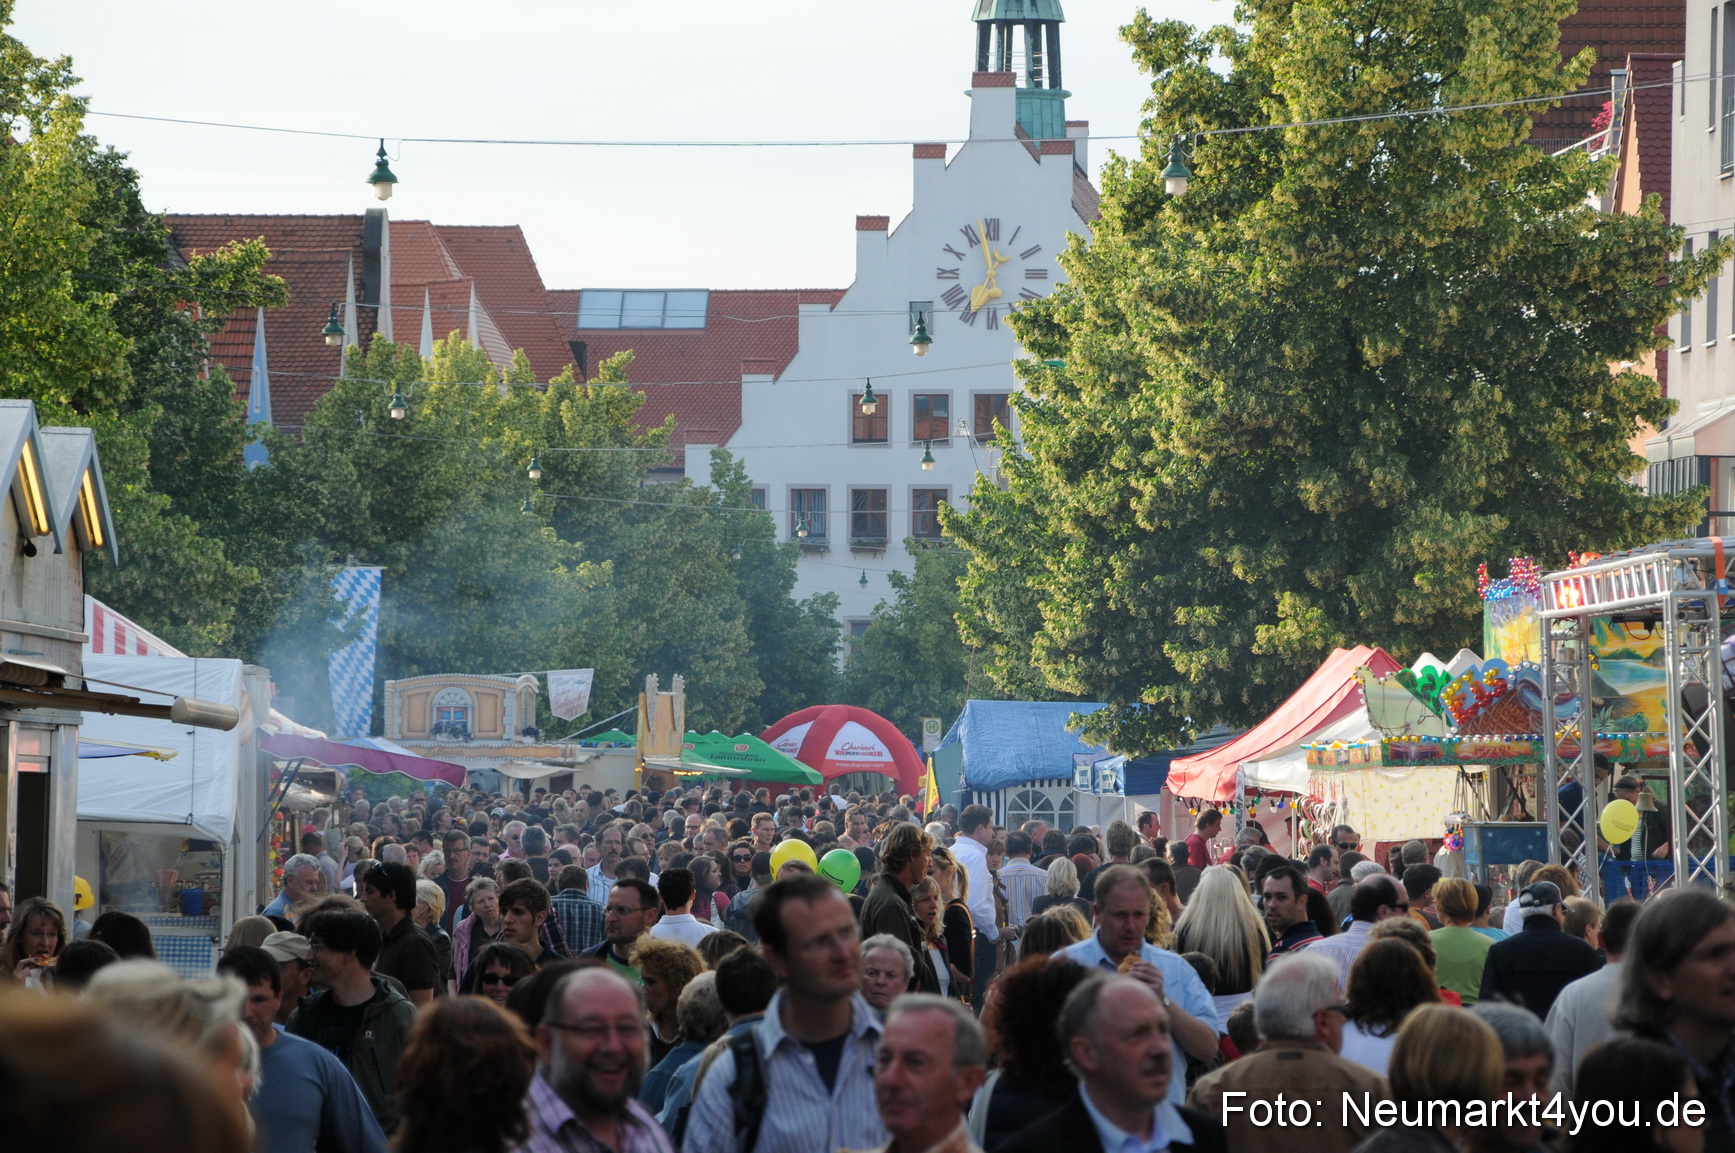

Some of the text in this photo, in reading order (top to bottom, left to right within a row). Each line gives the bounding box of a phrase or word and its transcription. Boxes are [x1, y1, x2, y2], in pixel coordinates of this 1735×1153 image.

[985, 218, 1000, 241] XII
[1441, 667, 1508, 725] EIS
[841, 742, 876, 751] Charivari
